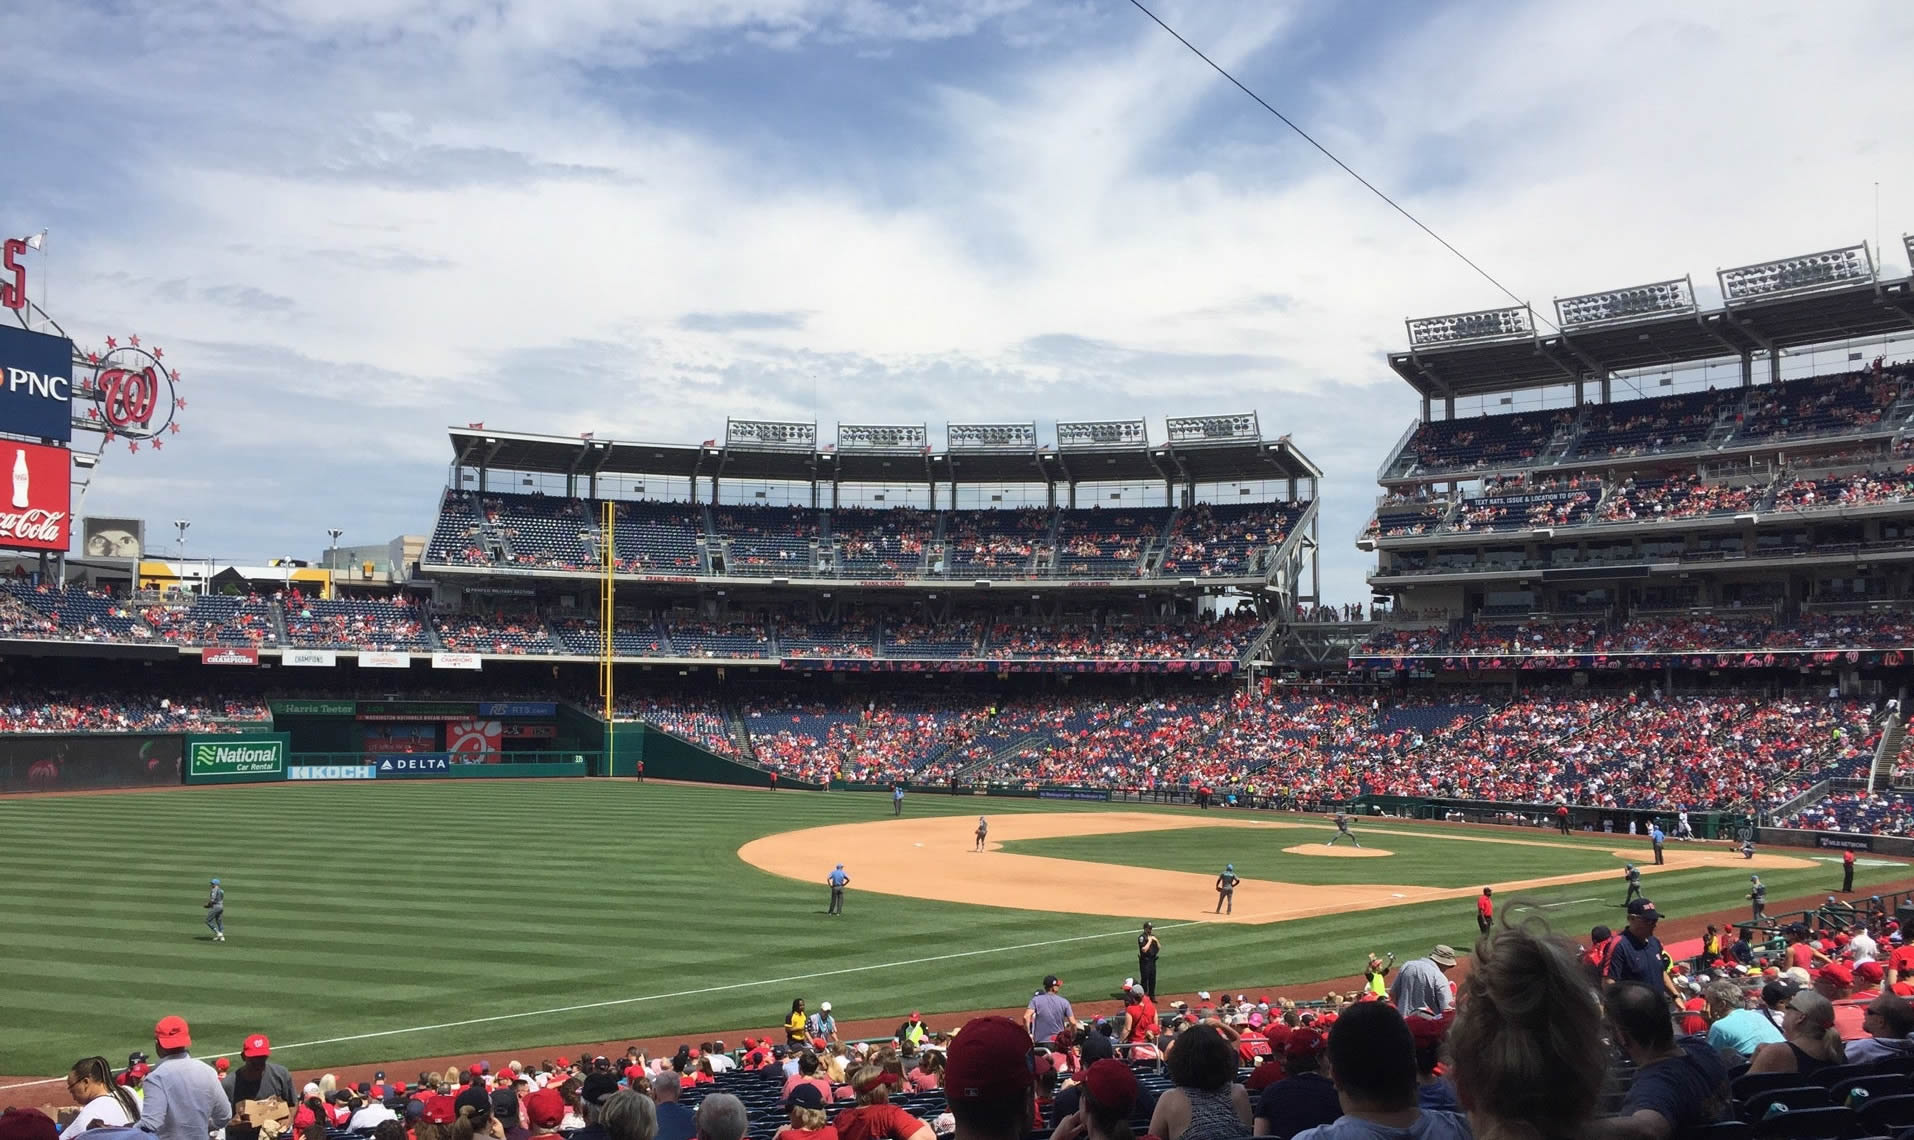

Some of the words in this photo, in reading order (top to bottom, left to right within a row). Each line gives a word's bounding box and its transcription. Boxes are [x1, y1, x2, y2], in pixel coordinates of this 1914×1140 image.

[3, 238, 26, 308] S
[7, 367, 68, 401] PNC
[1506, 496, 1523, 504] ISSUE
[1531, 493, 1557, 502] LOCATION
[294, 655, 324, 664] CHAMPIONS
[286, 703, 318, 713] Harris
[320, 704, 353, 713] Teeter
[215, 746, 277, 763] National
[237, 763, 249, 771] Car
[397, 759, 446, 769] DELTA
